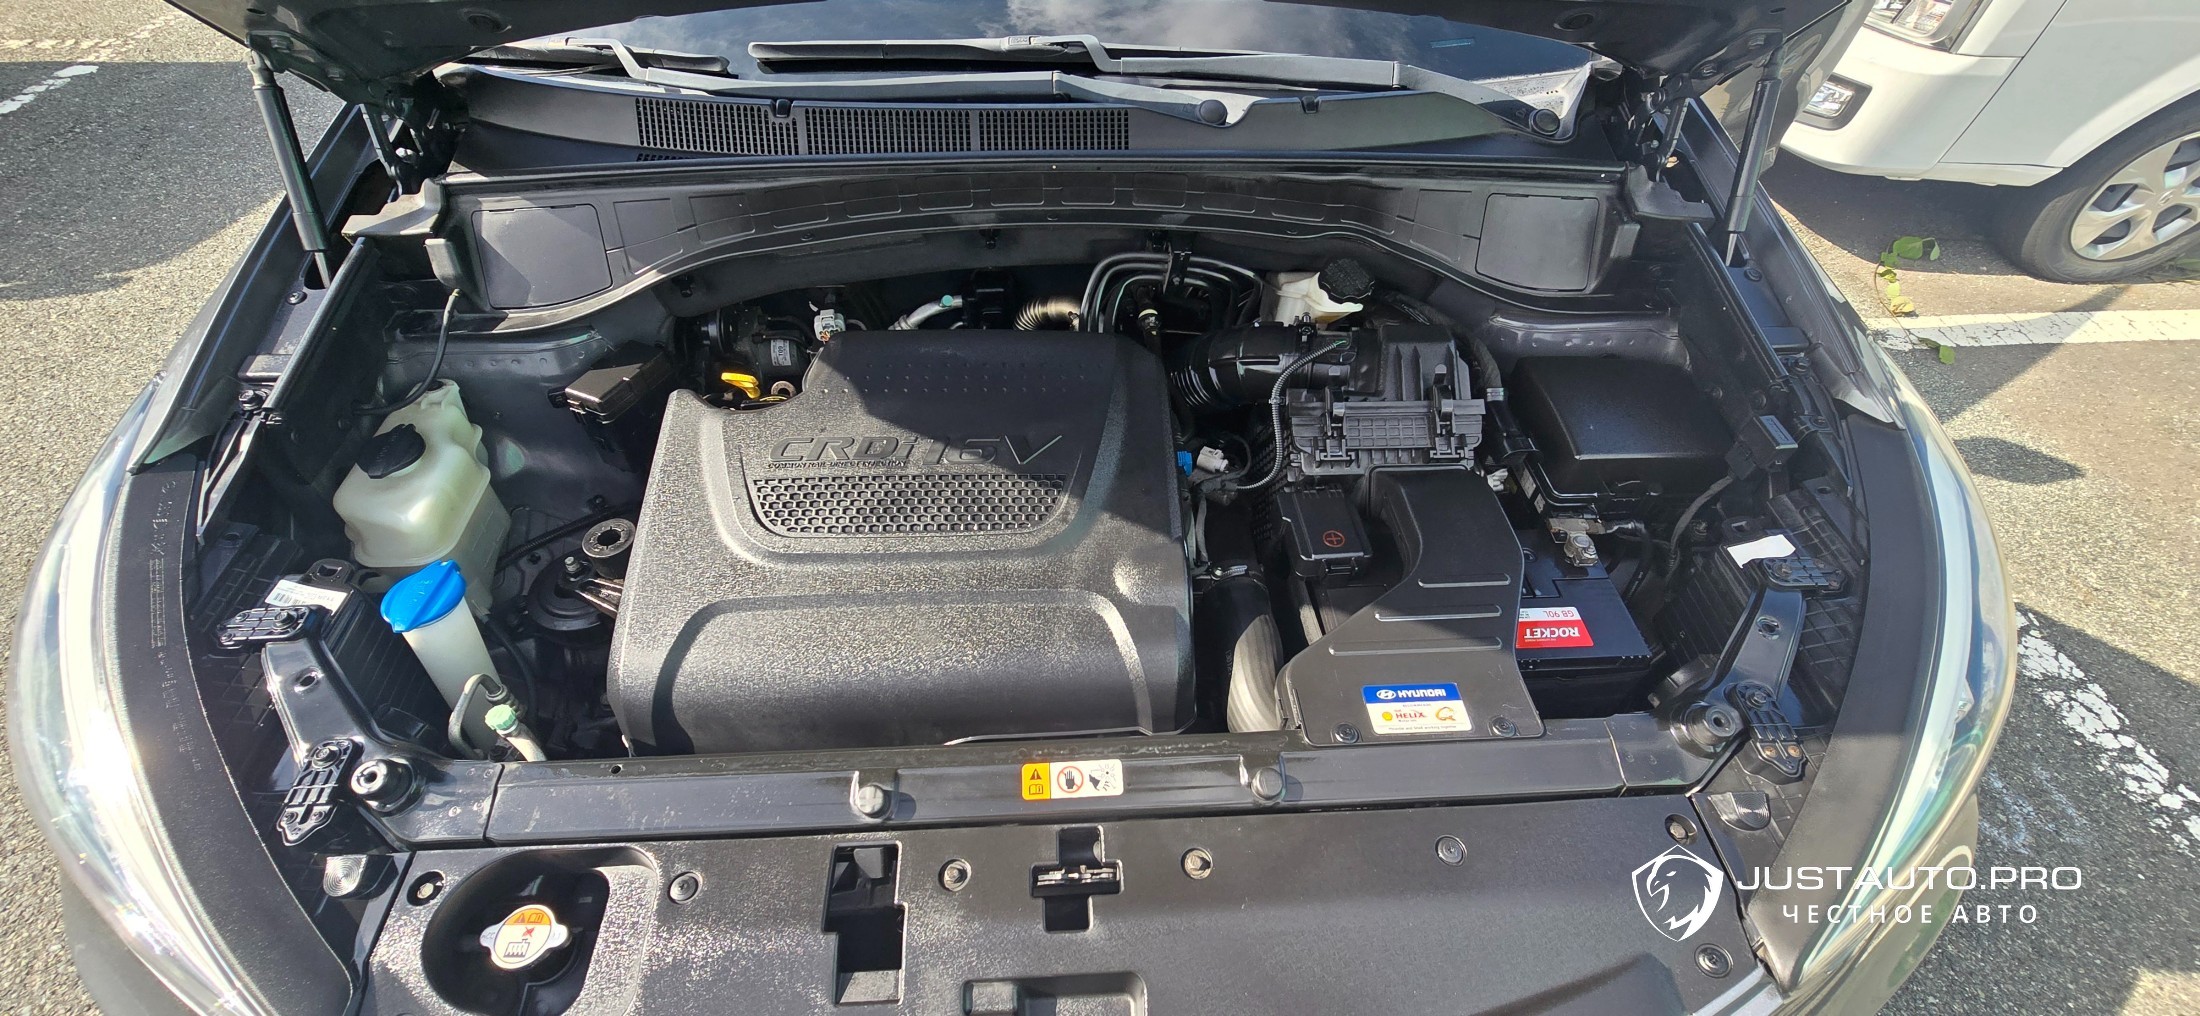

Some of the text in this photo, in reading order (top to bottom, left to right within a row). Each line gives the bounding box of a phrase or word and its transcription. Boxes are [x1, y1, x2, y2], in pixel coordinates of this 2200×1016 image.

[768, 436, 918, 461] CRDi
[1524, 627, 1580, 639] ROCKET
[1397, 688, 1447, 698] HYUNDAI
